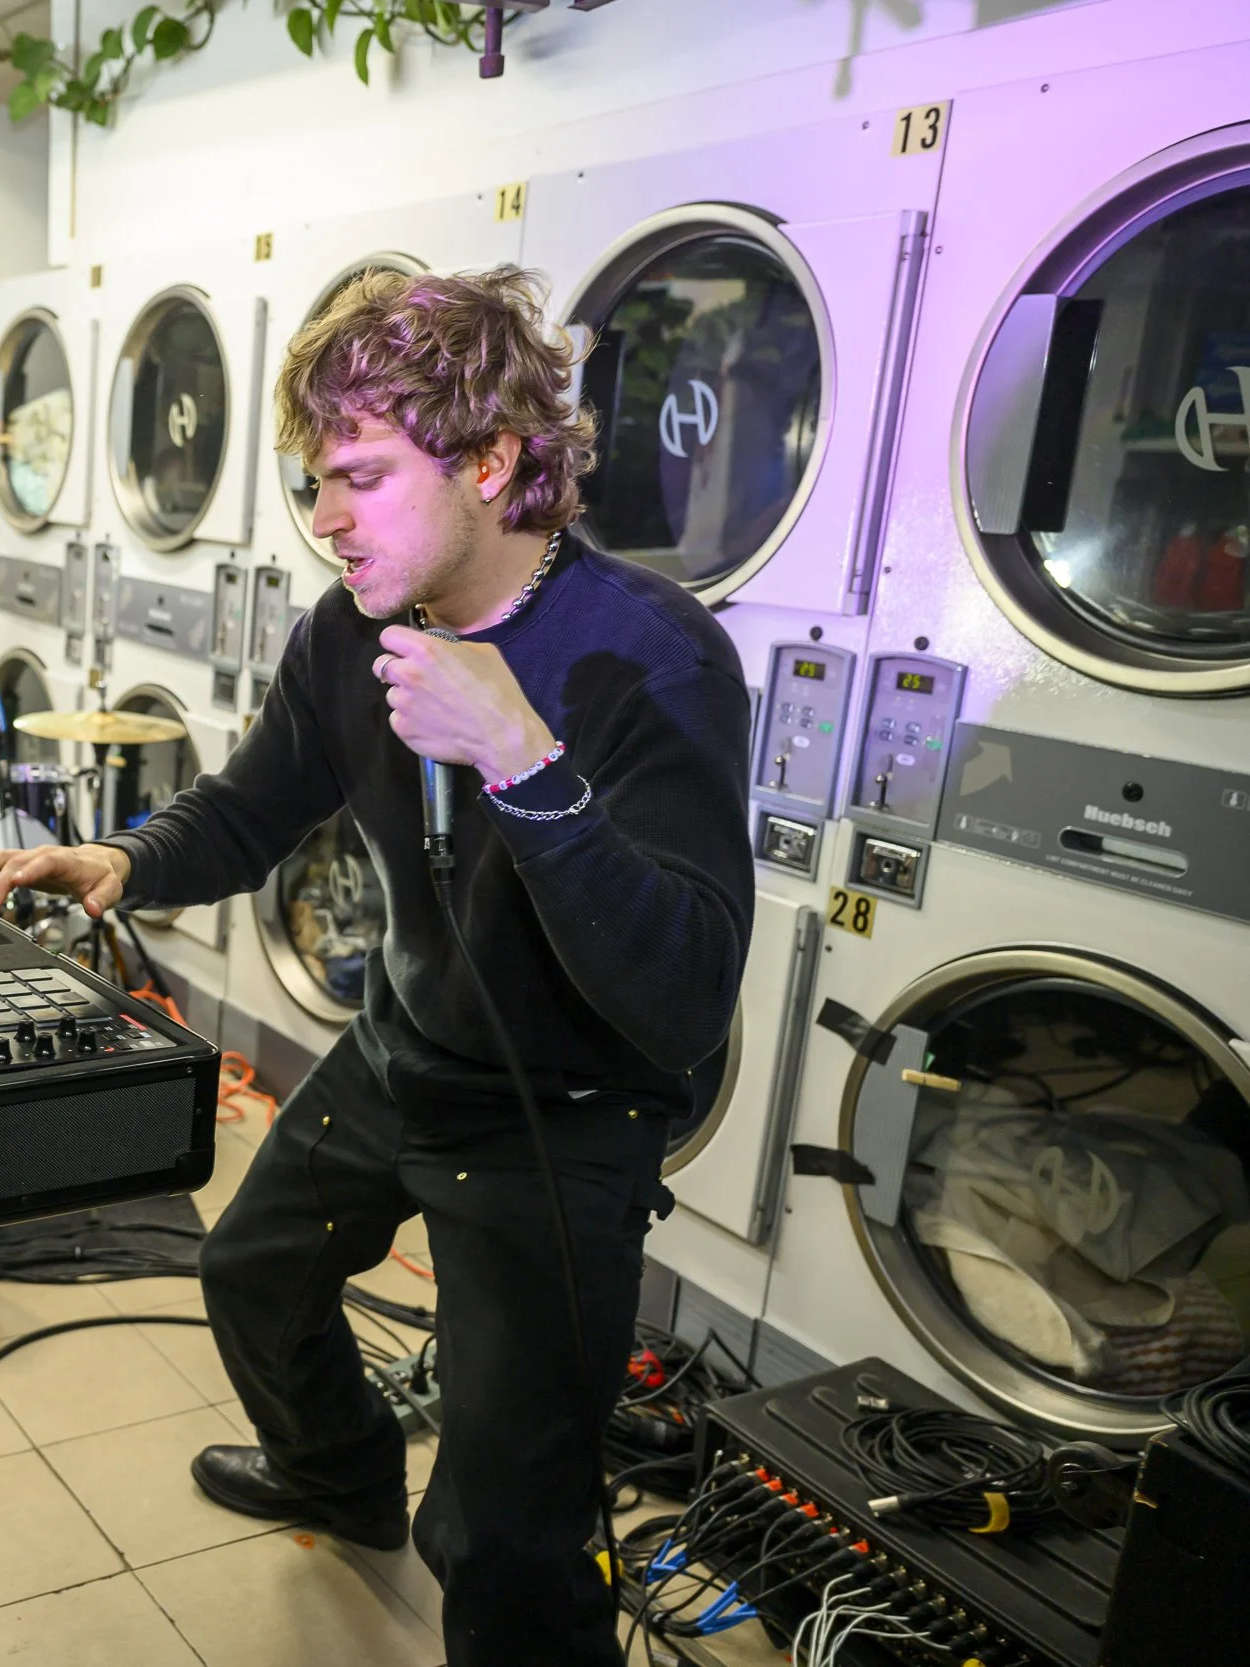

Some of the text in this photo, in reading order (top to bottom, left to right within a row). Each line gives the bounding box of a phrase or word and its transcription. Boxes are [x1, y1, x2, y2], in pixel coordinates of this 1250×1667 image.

[901, 107, 940, 153] 13
[499, 186, 521, 219] 14
[1084, 804, 1172, 838] Huebsch
[830, 891, 871, 933] 28
